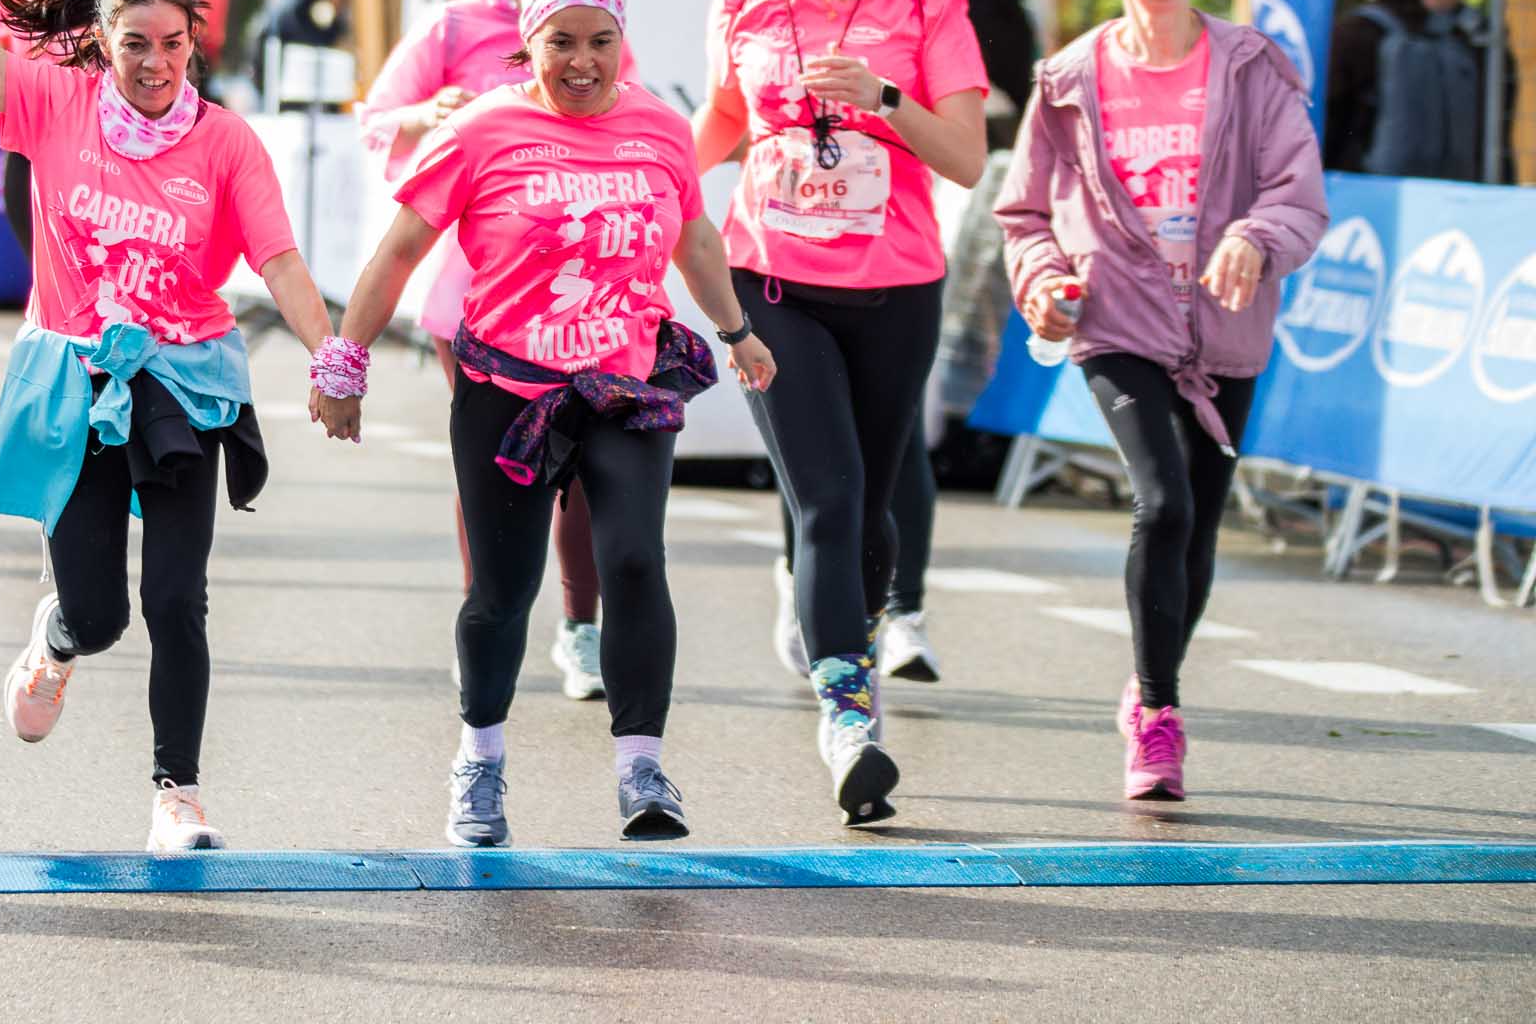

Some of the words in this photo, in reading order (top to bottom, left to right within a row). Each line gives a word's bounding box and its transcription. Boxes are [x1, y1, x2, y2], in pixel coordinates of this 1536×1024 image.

[511, 145, 571, 161] OYSHO
[598, 212, 642, 258] DE
[118, 247, 160, 301] DE
[526, 316, 630, 362] MUJER
